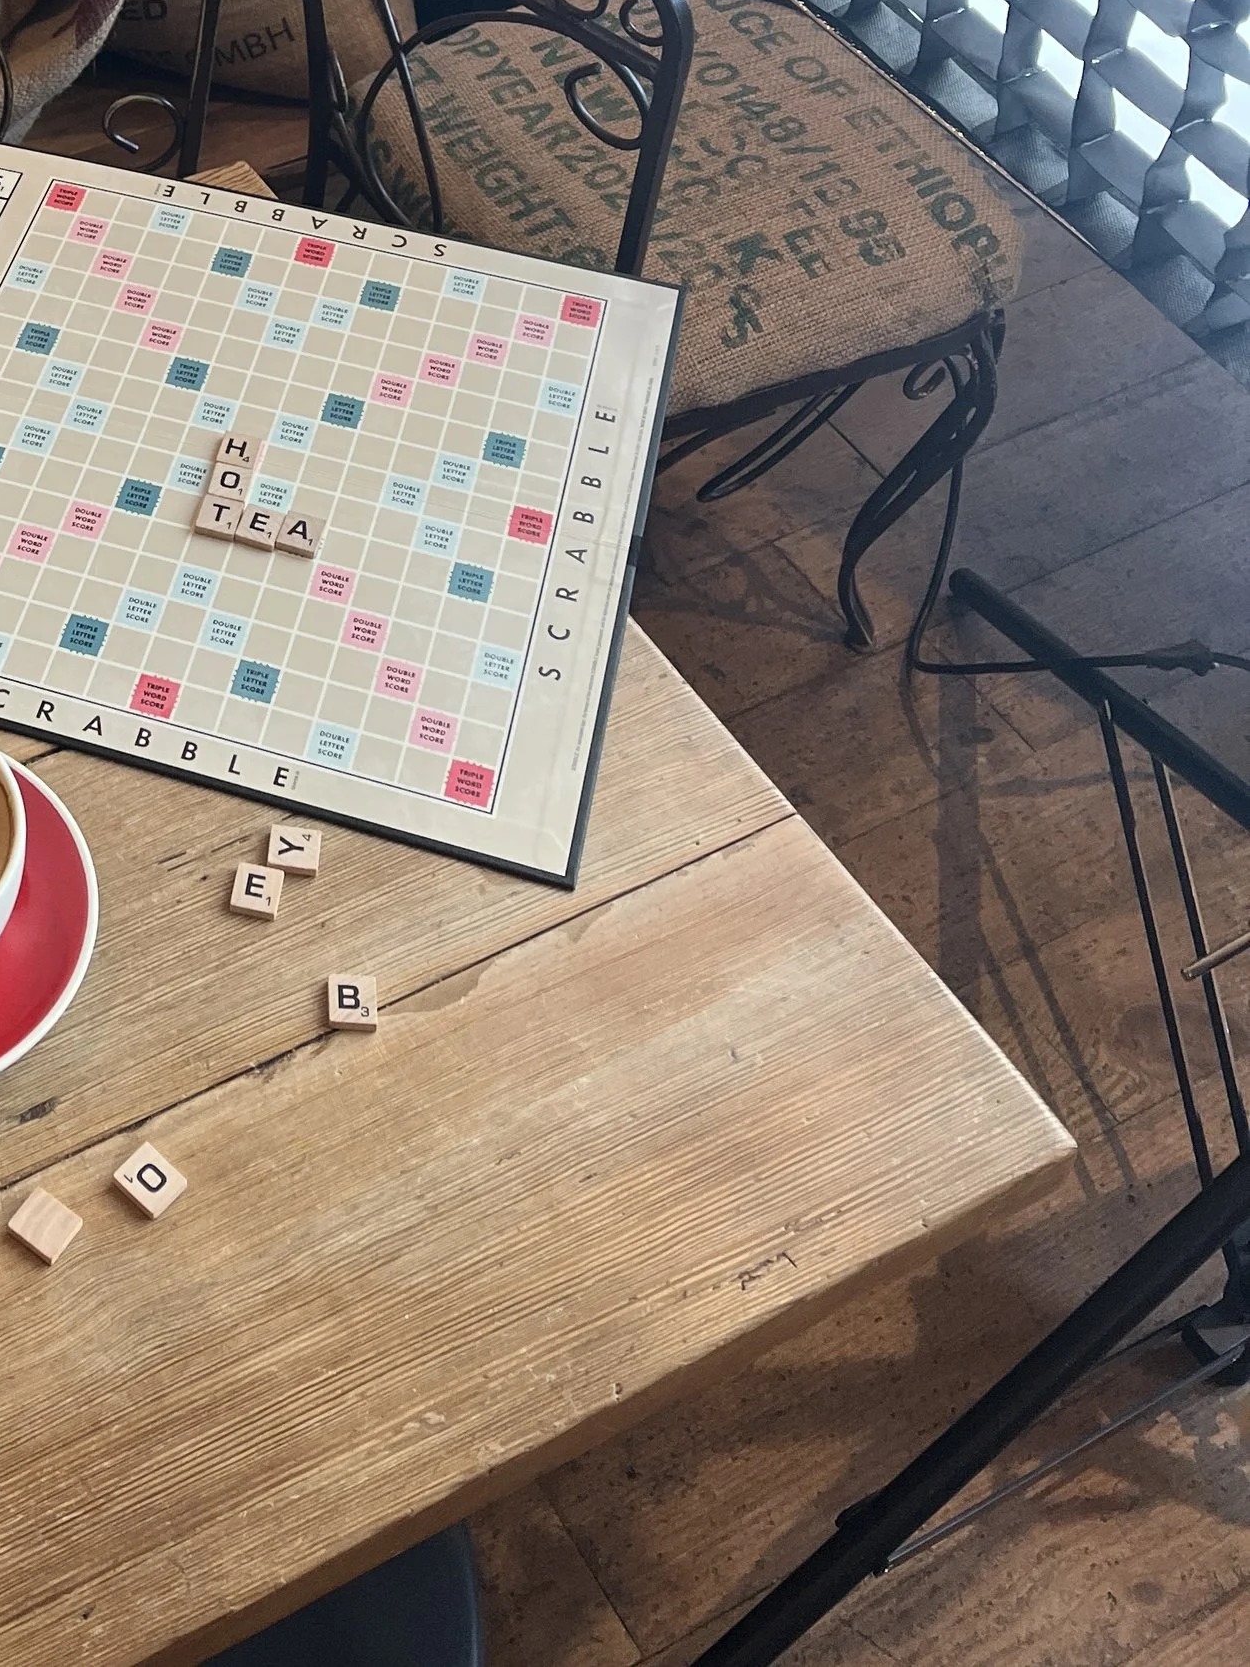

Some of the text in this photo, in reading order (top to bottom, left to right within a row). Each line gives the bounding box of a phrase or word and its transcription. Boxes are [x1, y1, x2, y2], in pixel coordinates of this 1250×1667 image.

[783, 56, 858, 99] OF
[55, 193, 76, 201] WORD
[58, 188, 78, 196] TRIPLE
[53, 198, 73, 206] SCORE
[303, 247, 325, 256] WORD
[306, 242, 327, 250] TRIPLE
[220, 258, 242, 266] LETTER
[223, 252, 243, 261] TRIPLE
[301, 253, 323, 262] SCORE
[218, 263, 240, 272] SCORE
[125, 294, 147, 303] WORD
[126, 288, 151, 298] DOUBLE
[123, 300, 144, 309] SCORE
[50, 371, 73, 381] LETTER
[51, 365, 78, 376] DOUBLE
[48, 378, 70, 387] SCORE
[182, 572, 212, 584] DOUBLE
[320, 570, 350, 582] DOUBLE
[182, 580, 207, 591] LETTER
[320, 578, 345, 589] WORD
[180, 587, 204, 598] SCORE
[318, 585, 342, 596] SCORE
[128, 596, 157, 609] DOUBLE
[127, 604, 152, 616] LETTER
[125, 612, 149, 623] SCORE
[352, 616, 382, 629] DOUBLE
[74, 621, 98, 633] TRIPLE
[211, 618, 242, 631] DOUBLE
[352, 624, 377, 636] WORD
[71, 629, 96, 640] LETTER
[211, 627, 237, 638] LETTER
[350, 632, 375, 644] SCORE
[68, 636, 93, 648] SCORE
[209, 634, 234, 646] SCORE
[245, 667, 269, 679] TRIPLE
[385, 665, 415, 678] DOUBLE
[241, 675, 268, 687] LETTER
[386, 673, 411, 685] WORD
[145, 682, 170, 693] TRIPLE
[239, 683, 265, 695] SCORE
[383, 681, 409, 693] SCORE
[142, 689, 167, 702] WORD
[139, 697, 165, 710] SCORE
[420, 715, 451, 729] DOUBLE
[420, 724, 446, 736] WORD
[418, 732, 444, 744] SCORE
[458, 768, 484, 780] TRIPLE
[455, 776, 482, 789] WORD
[454, 785, 481, 798] SCORE
[277, 835, 305, 856] Y
[244, 873, 266, 899] E
[337, 984, 361, 1010] B
[136, 1162, 167, 1193] O
